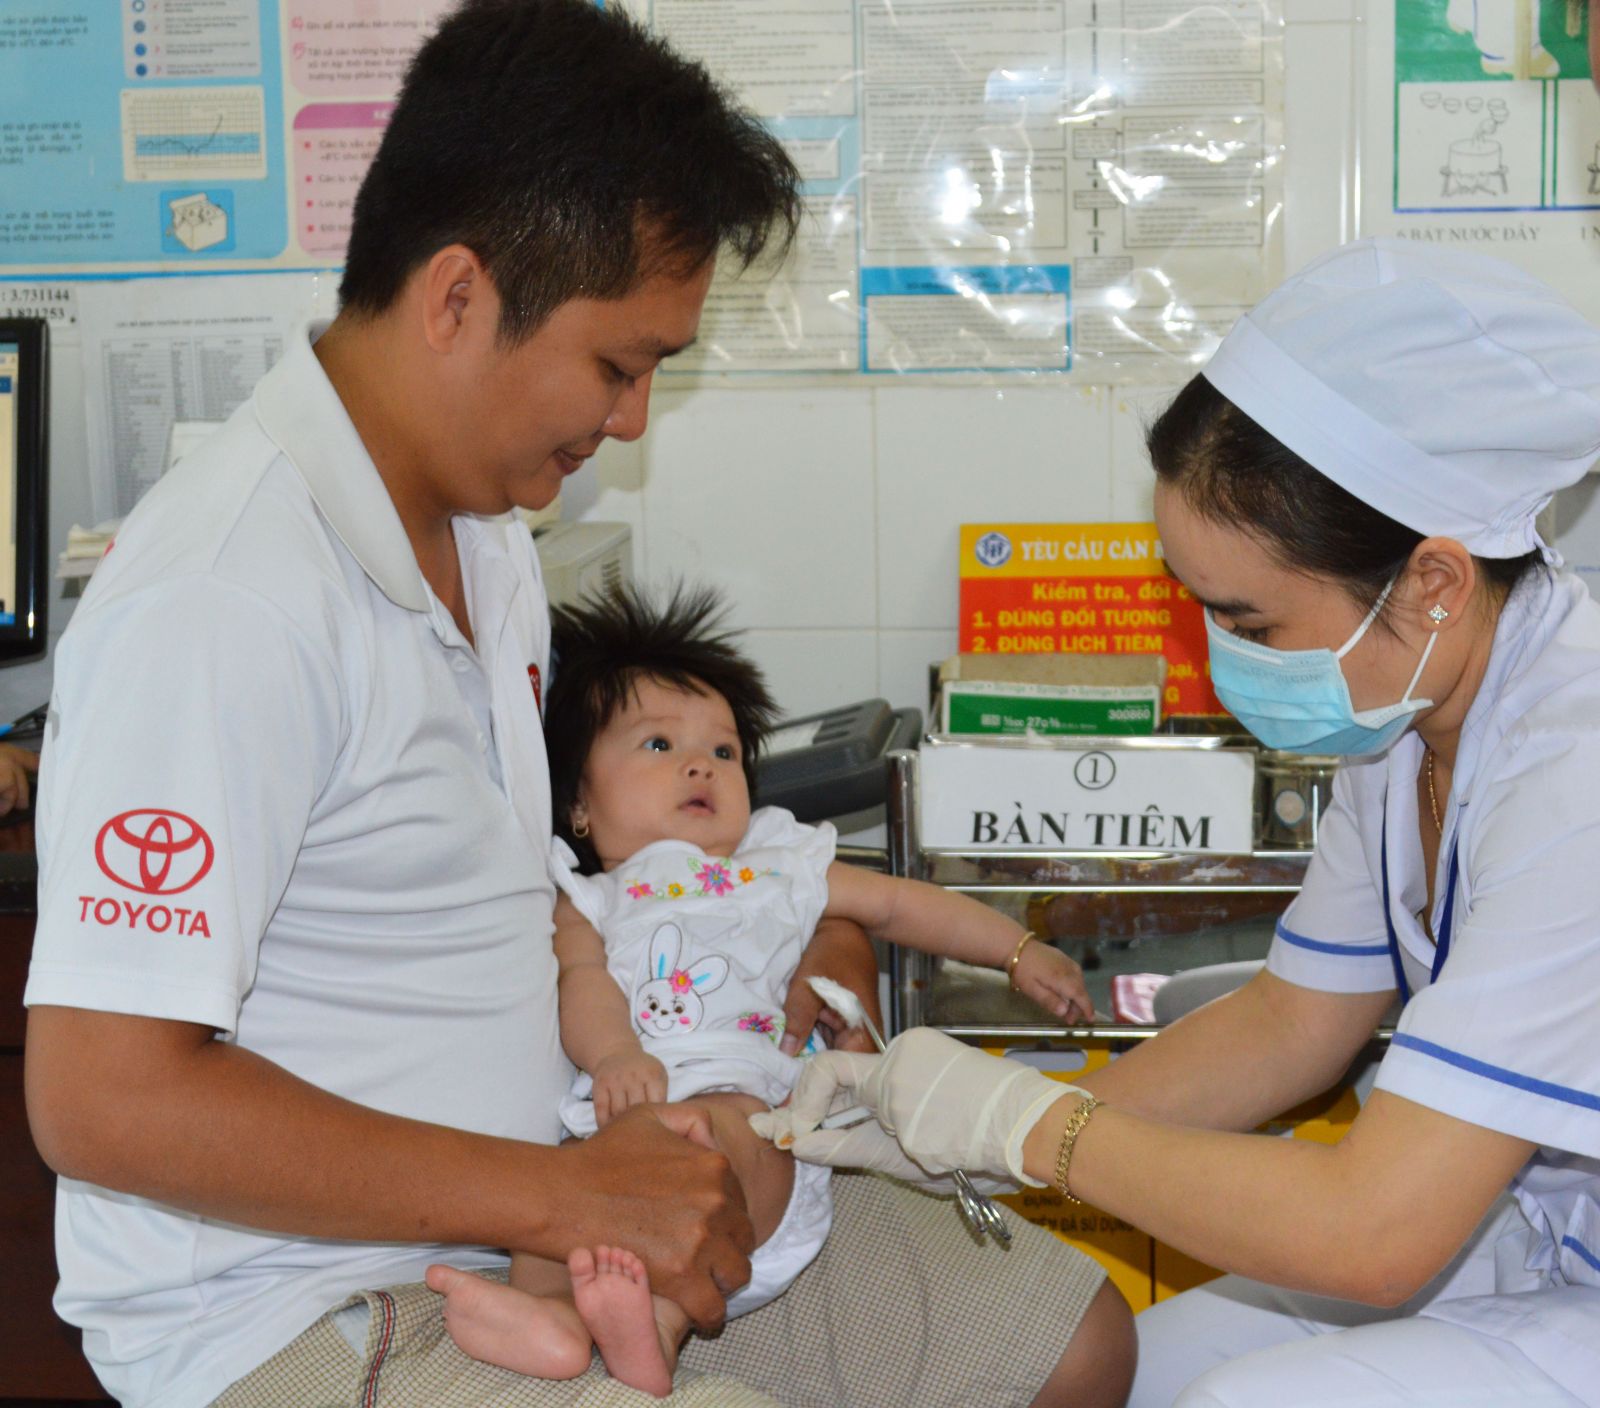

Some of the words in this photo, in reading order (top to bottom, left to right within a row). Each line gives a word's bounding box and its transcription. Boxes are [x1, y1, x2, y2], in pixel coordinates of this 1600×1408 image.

[1093, 583, 1132, 604] tra,
[972, 611, 992, 628] 1.
[972, 635, 992, 653] 2.
[969, 801, 1071, 844] BÀN
[1084, 804, 1215, 849] TIÊM
[78, 895, 212, 939] TOYOTA
